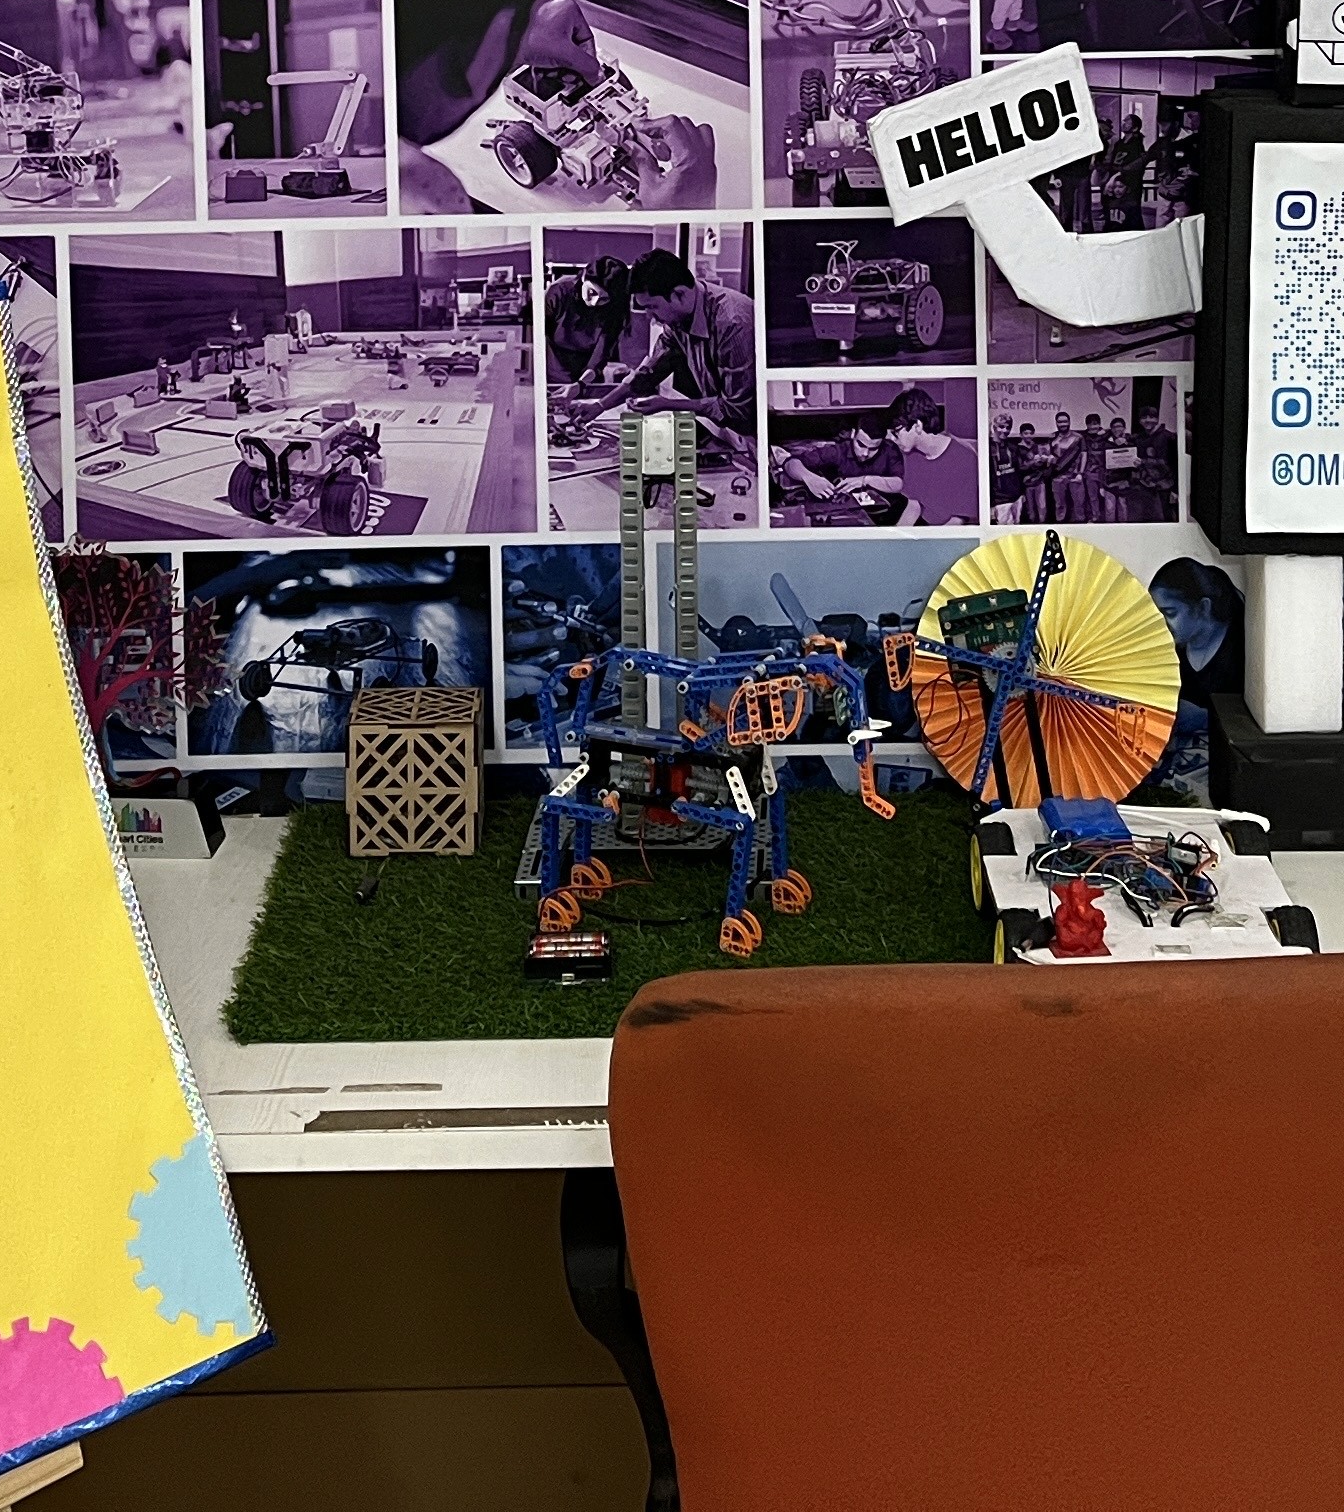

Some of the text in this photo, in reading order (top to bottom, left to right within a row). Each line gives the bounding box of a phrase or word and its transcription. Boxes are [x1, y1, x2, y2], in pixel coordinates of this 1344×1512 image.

[896, 79, 1080, 189] HELLO!
[1018, 381, 1041, 393] and
[1000, 398, 1062, 412] Ceremony
